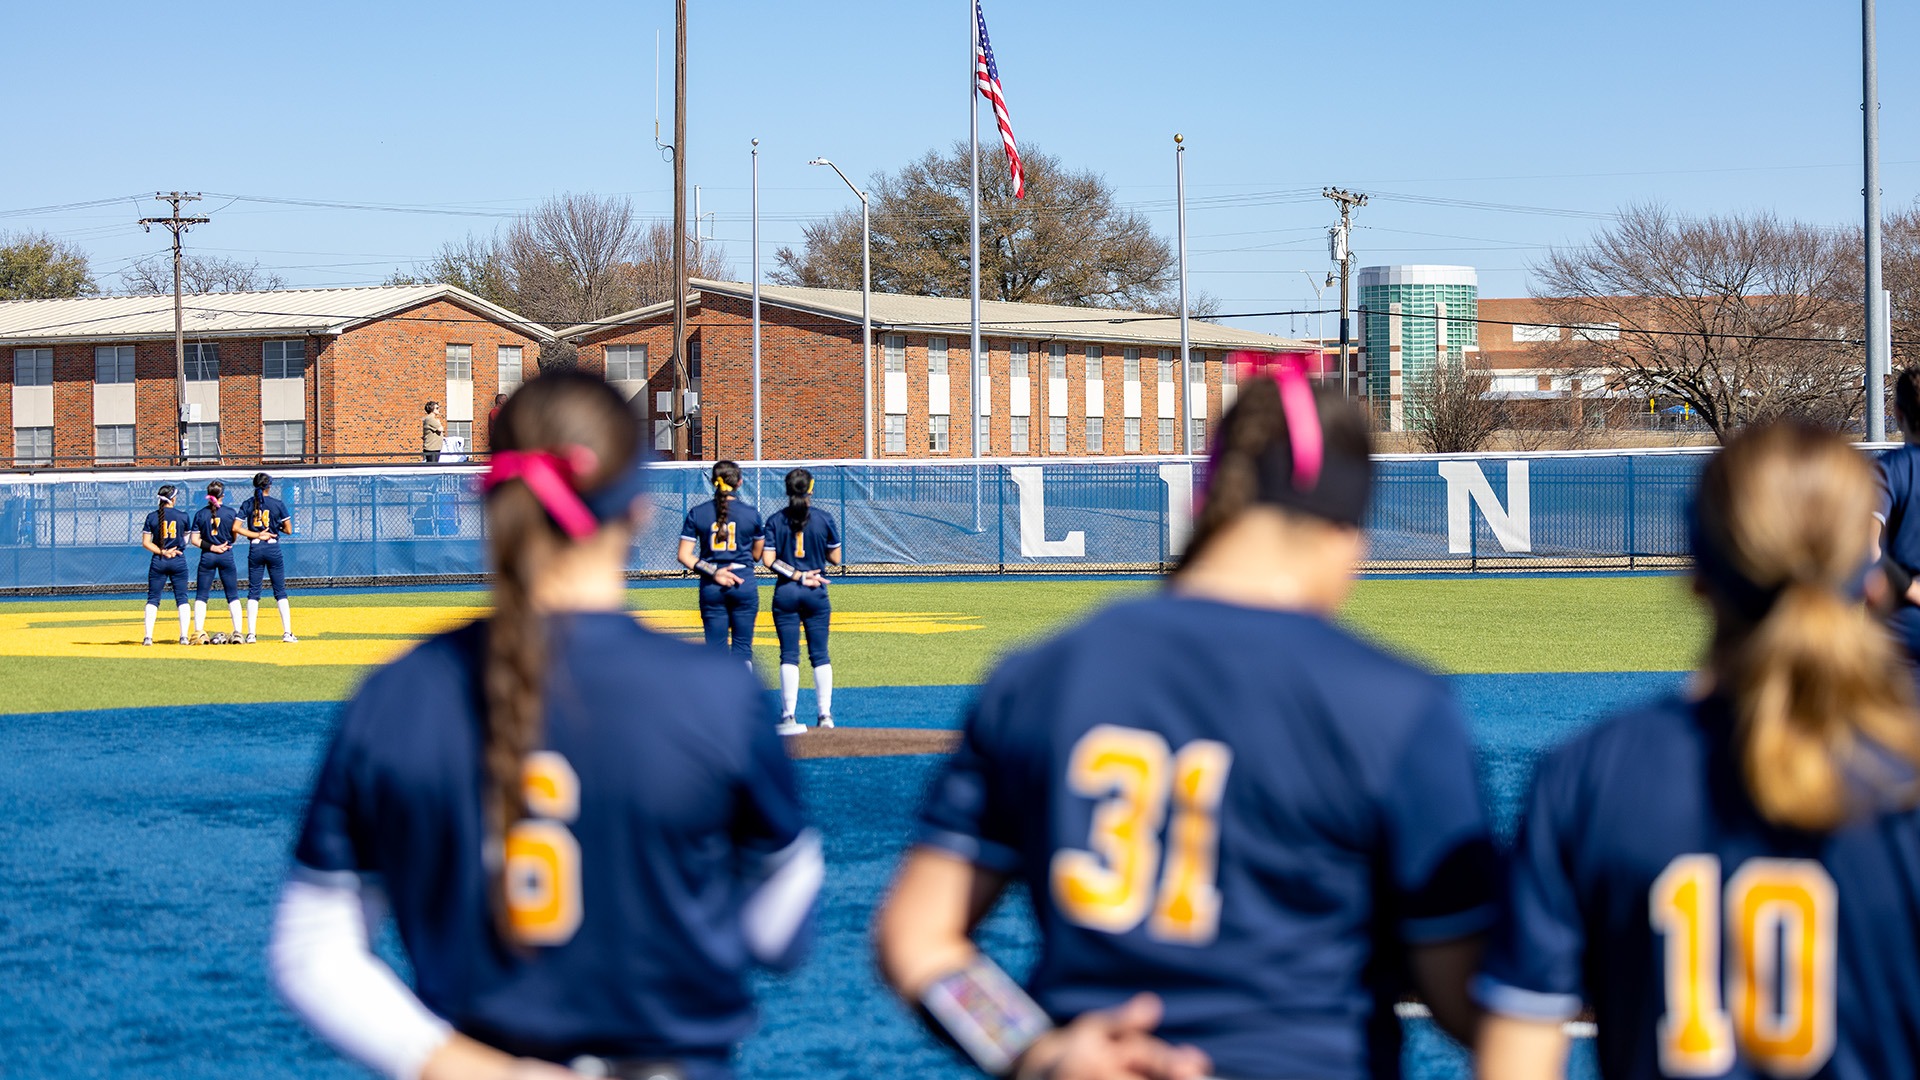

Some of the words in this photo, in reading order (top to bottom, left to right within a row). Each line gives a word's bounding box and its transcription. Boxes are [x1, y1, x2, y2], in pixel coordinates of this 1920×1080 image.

[252, 509, 270, 528] 24
[710, 521, 737, 552] 21
[794, 531, 806, 559] 1
[482, 749, 584, 946] 6
[1048, 722, 1234, 948] 31
[1648, 852, 1839, 1080] 10
